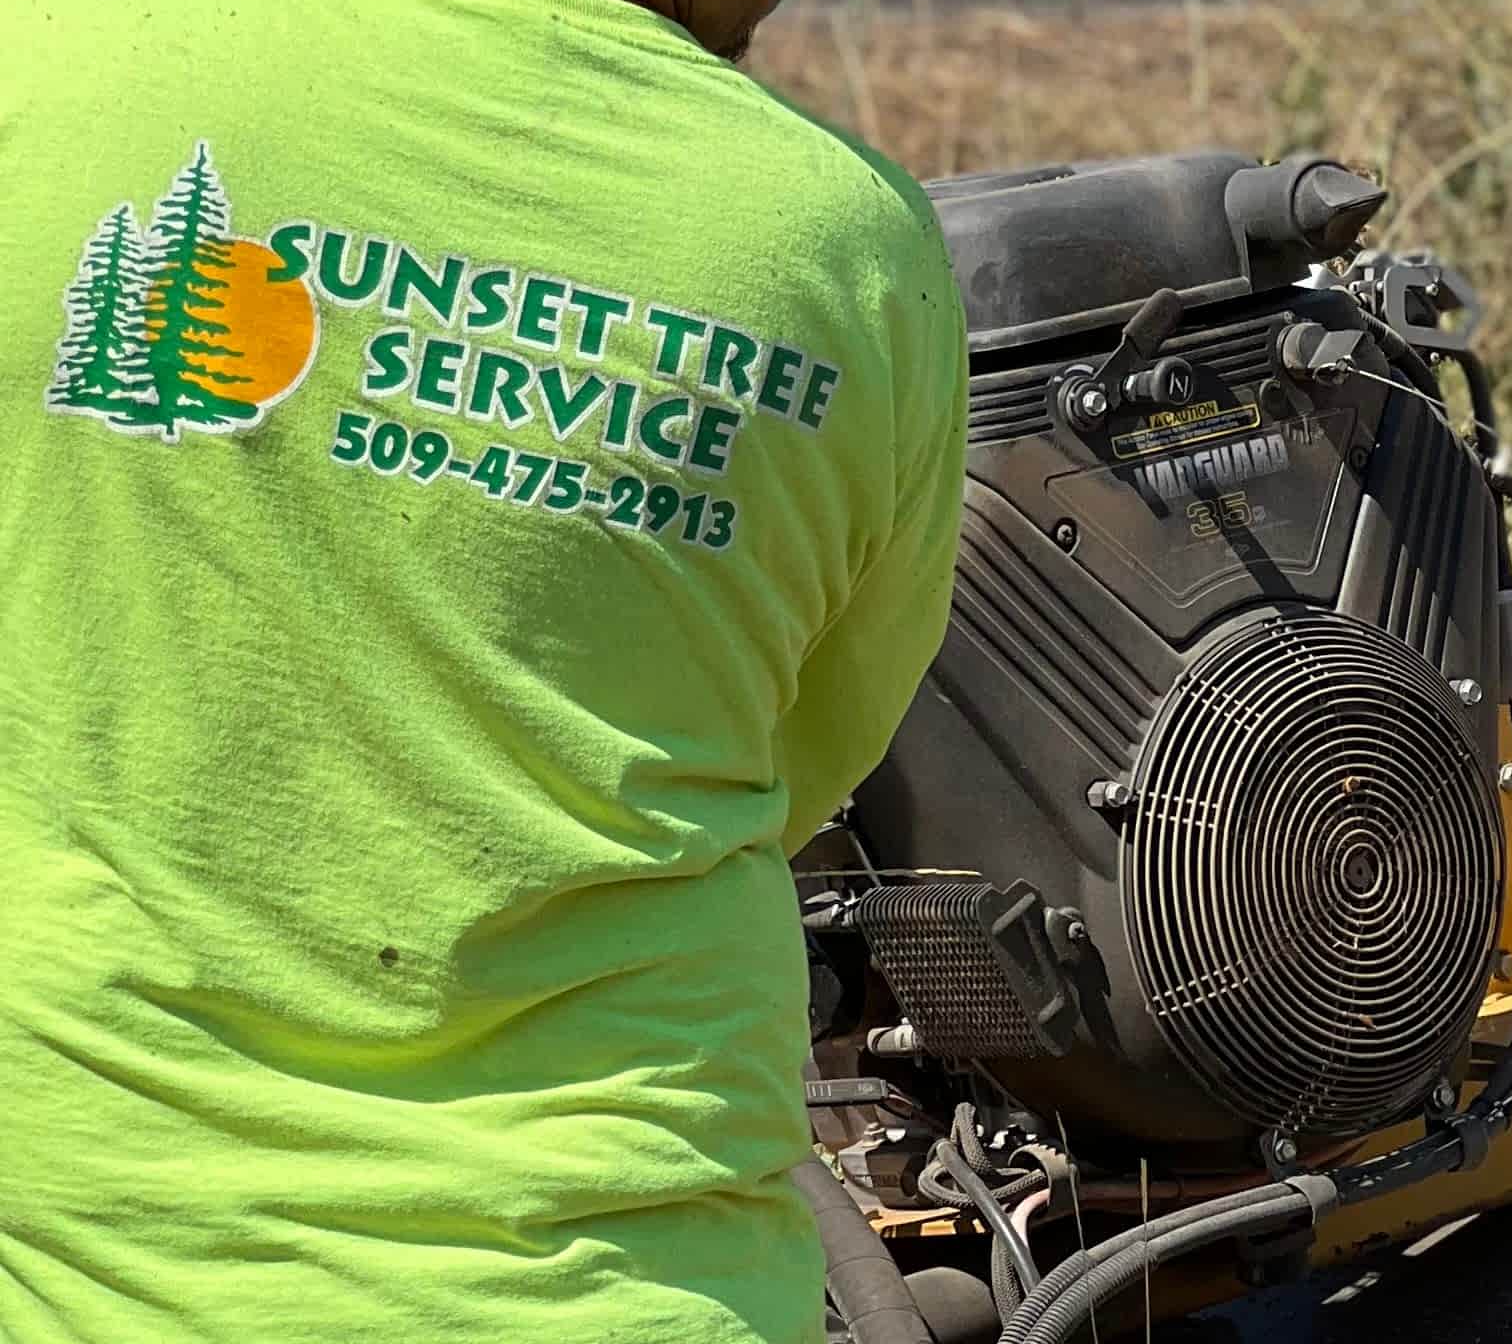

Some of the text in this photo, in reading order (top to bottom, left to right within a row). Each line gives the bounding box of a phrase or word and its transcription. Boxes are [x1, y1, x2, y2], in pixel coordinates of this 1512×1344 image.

[267, 224, 840, 430] SUNSET TREE
[367, 332, 741, 472] SERVICE
[1164, 403, 1216, 425] CAUTION
[331, 413, 737, 549] 509-475-2913
[1133, 433, 1289, 498] VANGUARD
[1186, 490, 1252, 538] 35
